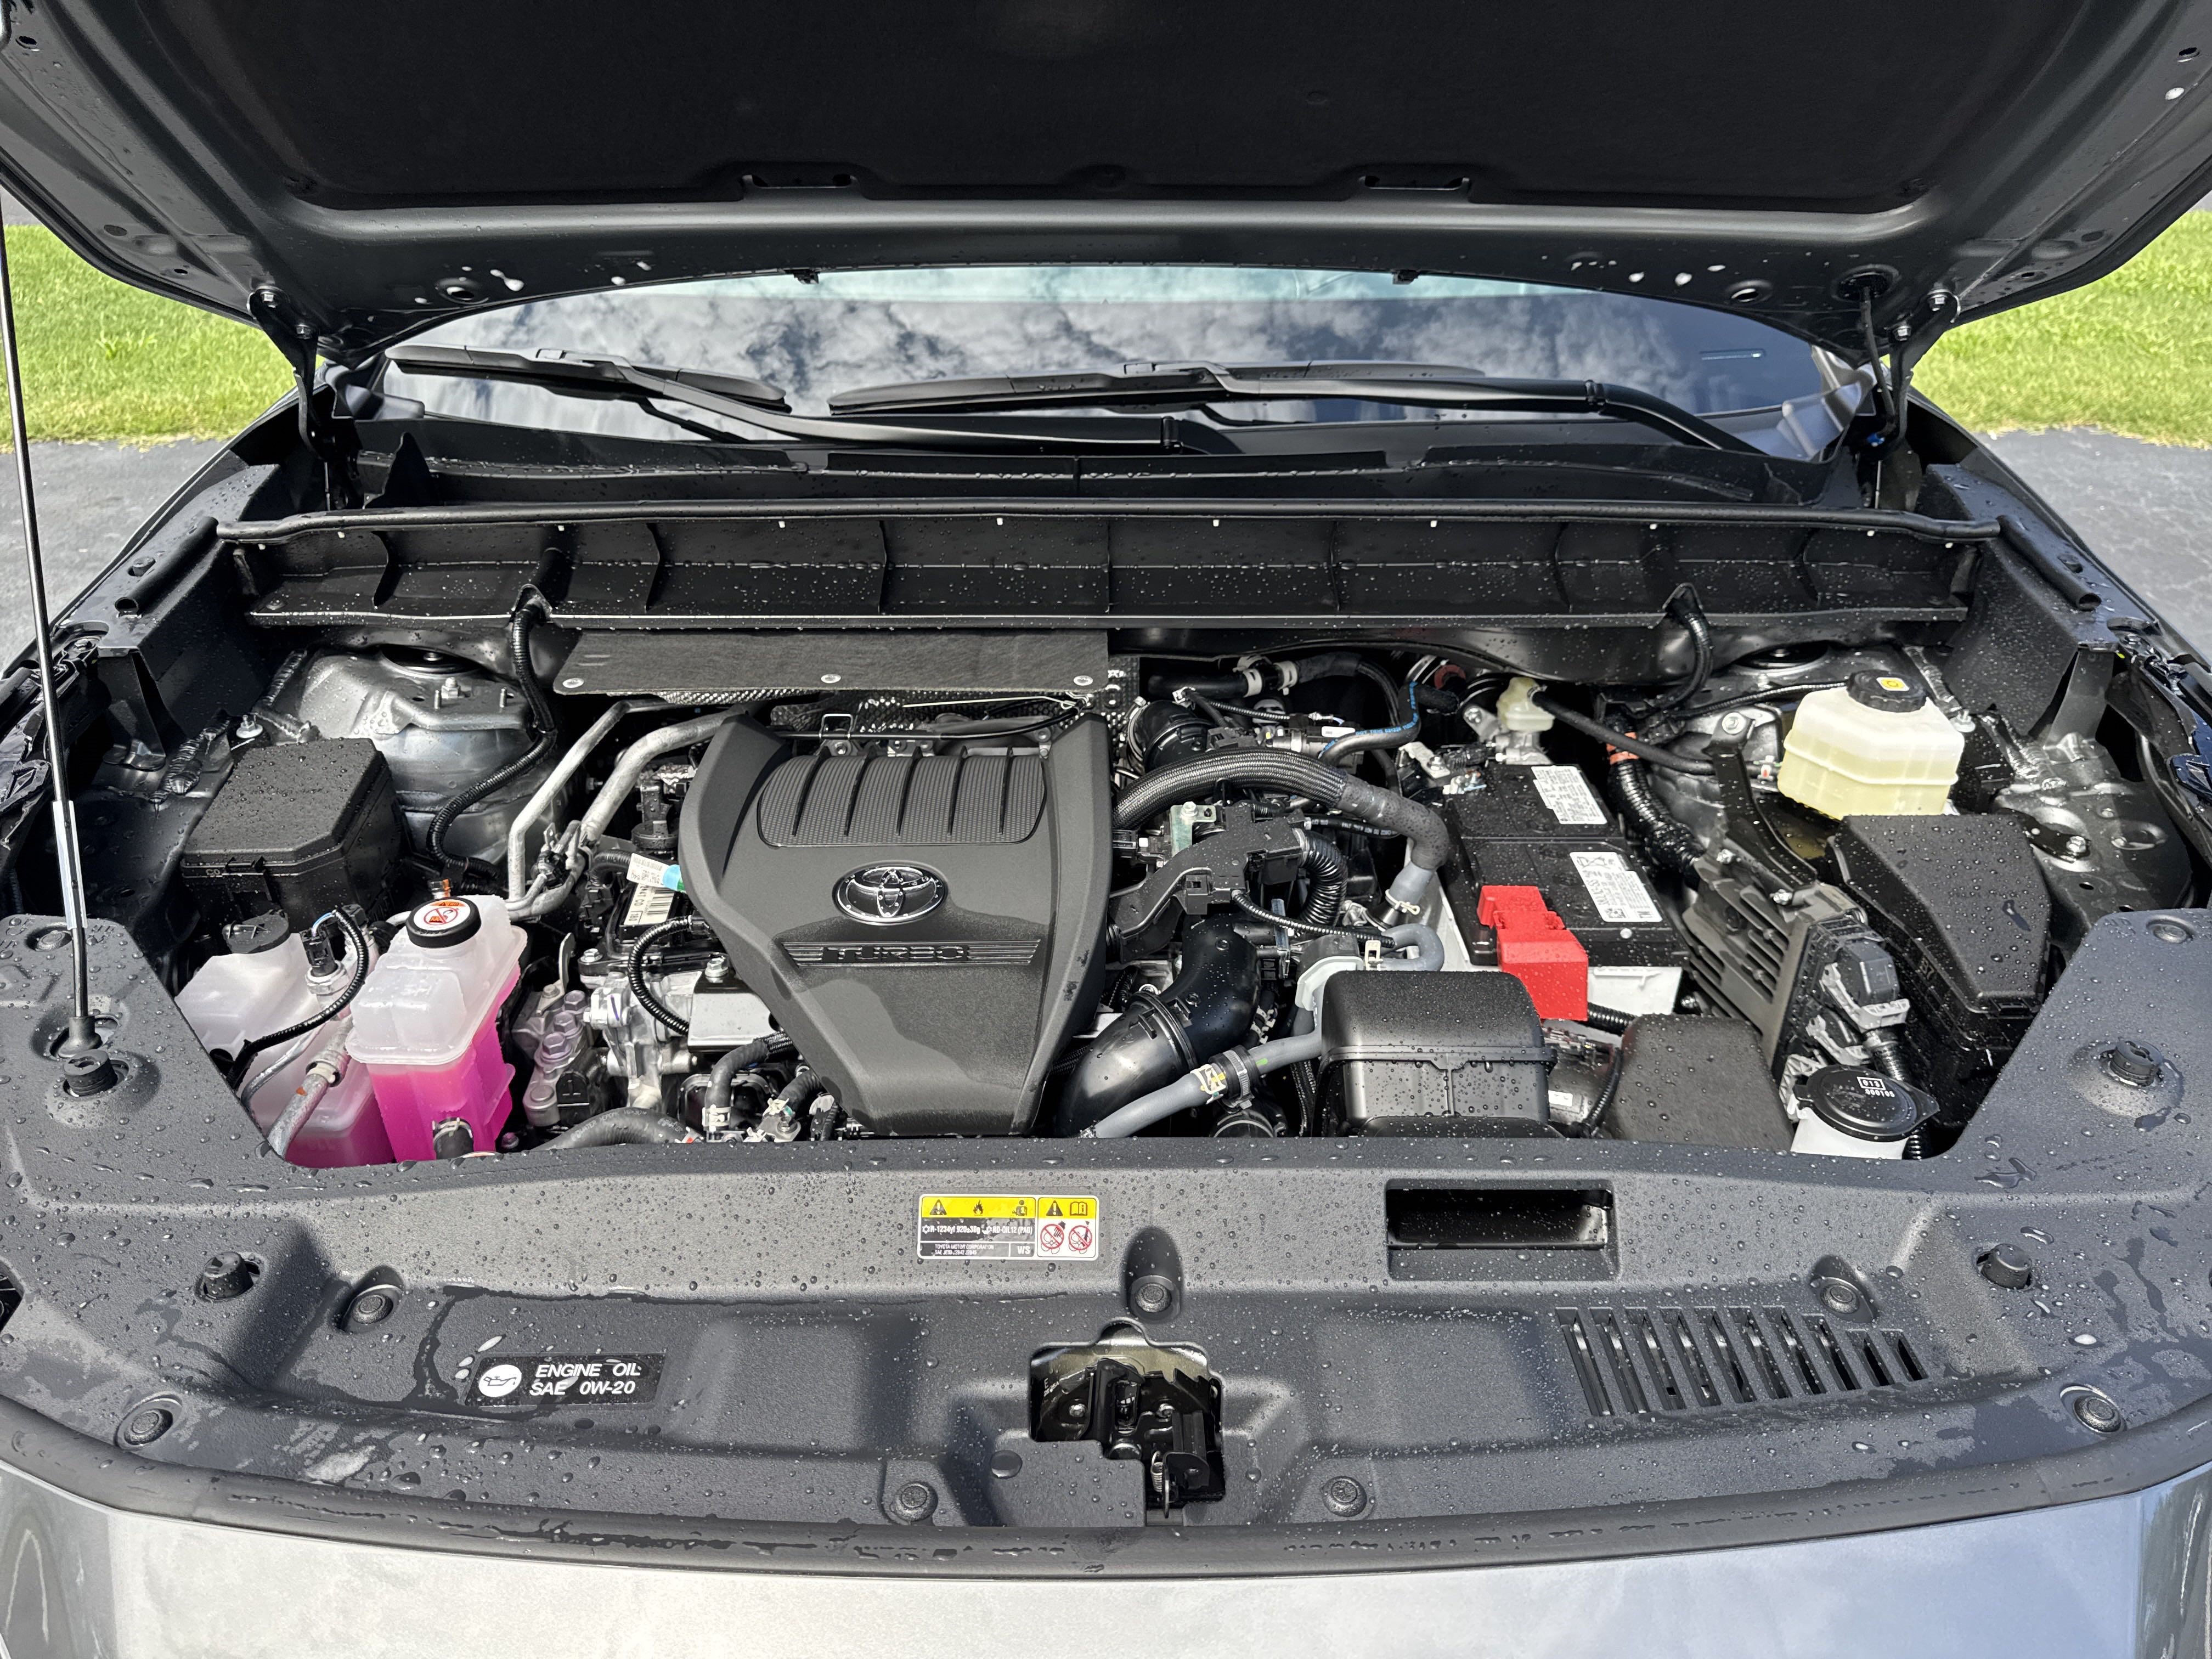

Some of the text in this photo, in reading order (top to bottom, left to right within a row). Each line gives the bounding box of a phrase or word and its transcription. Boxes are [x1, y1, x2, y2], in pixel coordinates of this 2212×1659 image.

[827, 946, 964, 961] TURBO
[929, 1226, 955, 1234] R-1234yf
[1017, 1245, 1030, 1255] WS
[535, 1363, 641, 1378] ENGINE OIL
[529, 1381, 636, 1396] SAE 0W-20
